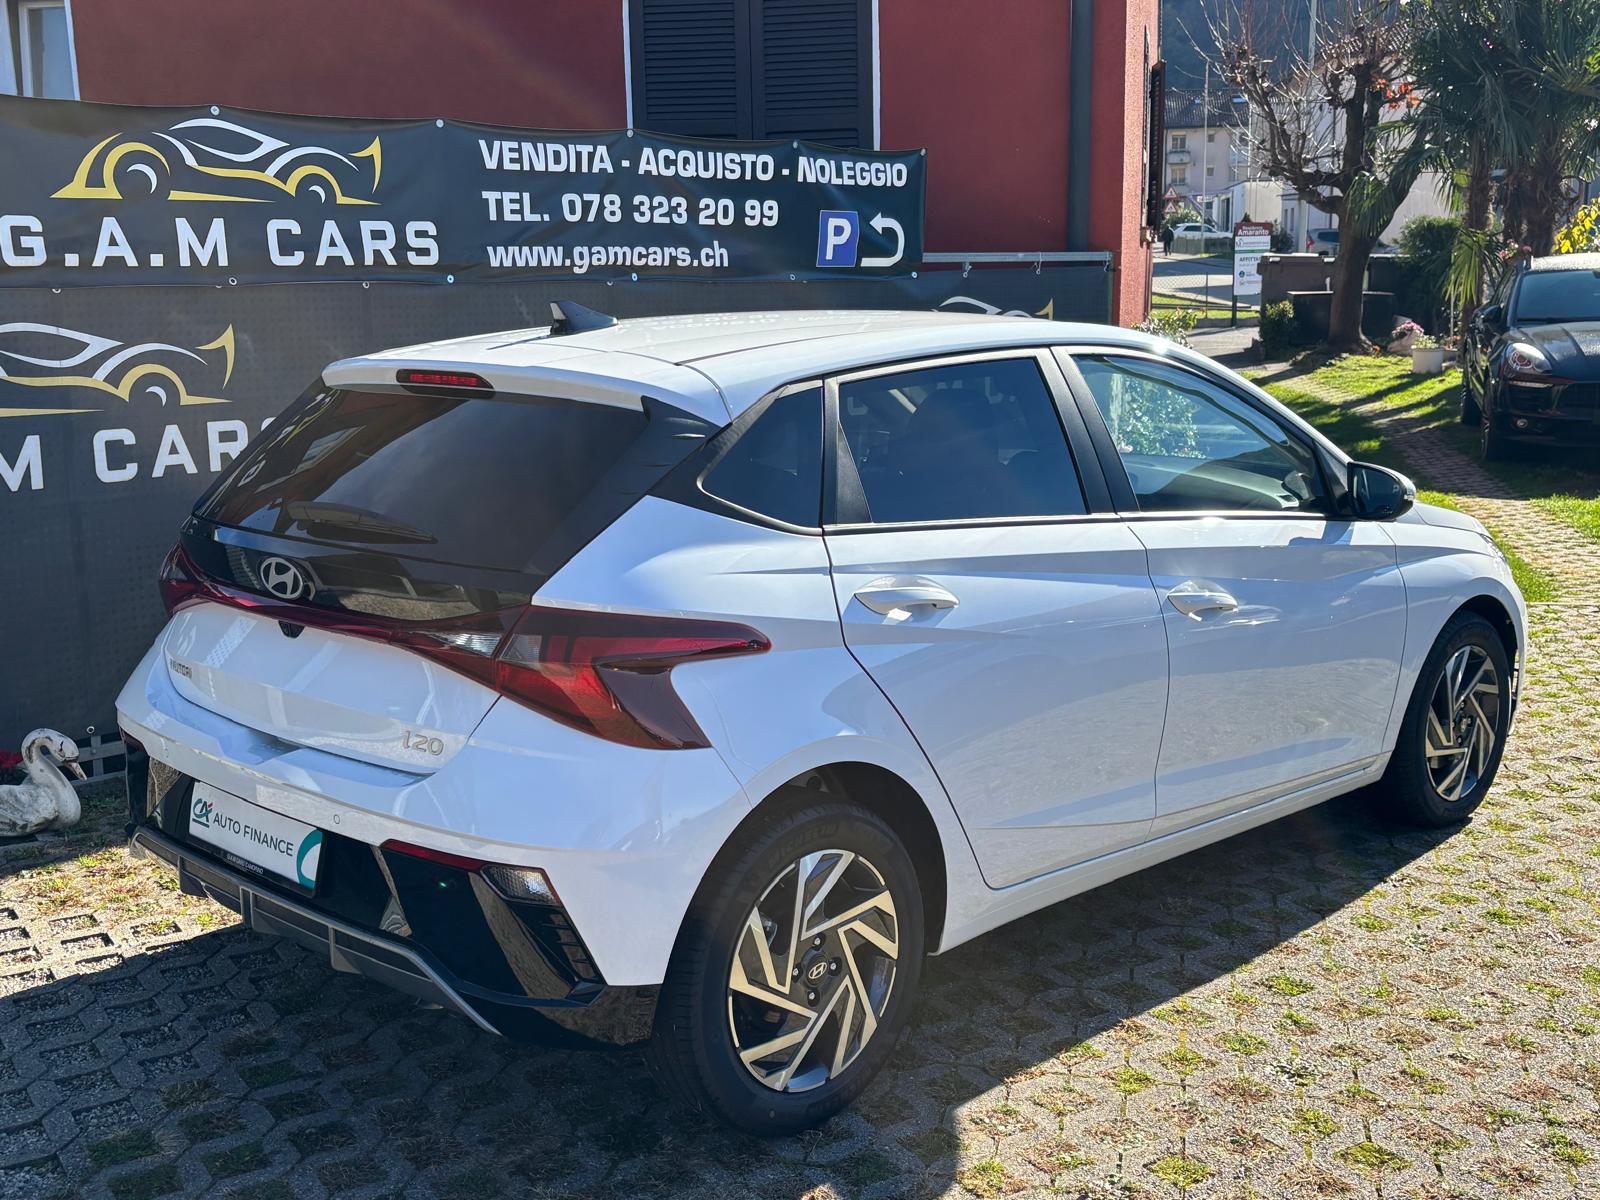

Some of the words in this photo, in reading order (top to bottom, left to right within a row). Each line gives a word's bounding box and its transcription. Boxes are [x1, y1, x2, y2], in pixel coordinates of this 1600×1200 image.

[478, 139, 614, 174] VENDITA
[637, 147, 775, 181] ACQUISTO
[797, 156, 908, 187] NOLEGGIO
[481, 190, 550, 222] TEL.
[561, 192, 622, 223] 078
[632, 194, 688, 225] 323
[698, 197, 735, 226] 20
[744, 199, 779, 227] 99
[0, 214, 229, 267] G.A.M
[266, 218, 440, 267] CARS
[825, 217, 852, 261] P
[1237, 228, 1269, 236] Amaranto
[486, 240, 729, 274] www.gamcars.ch
[93, 417, 277, 483] CAR
[213, 812, 241, 834] AUTO
[243, 825, 294, 857] FINANCE
